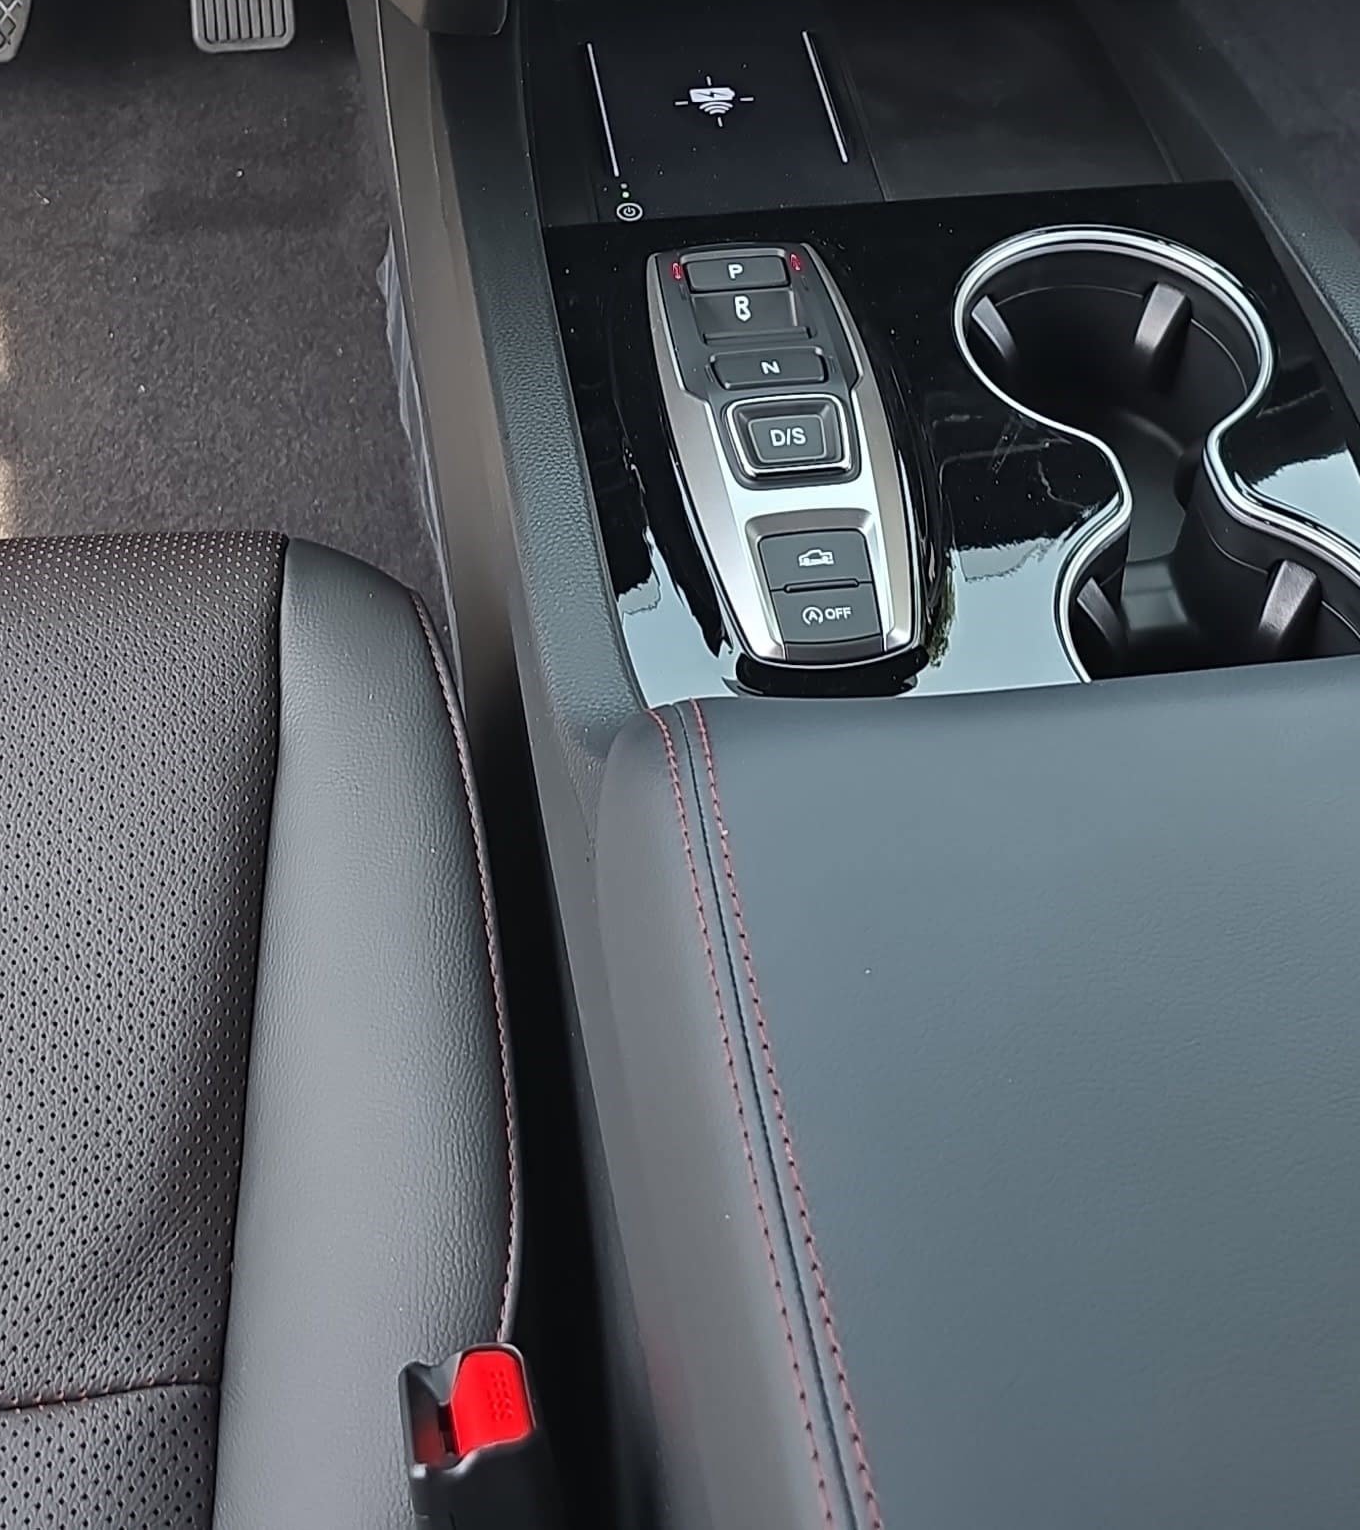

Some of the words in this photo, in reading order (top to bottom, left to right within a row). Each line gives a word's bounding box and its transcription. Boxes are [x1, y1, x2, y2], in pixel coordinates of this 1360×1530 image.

[728, 264, 743, 279] P
[735, 295, 751, 317] R
[760, 361, 780, 374] N
[770, 427, 806, 447] D/S
[825, 606, 851, 620] OFF
